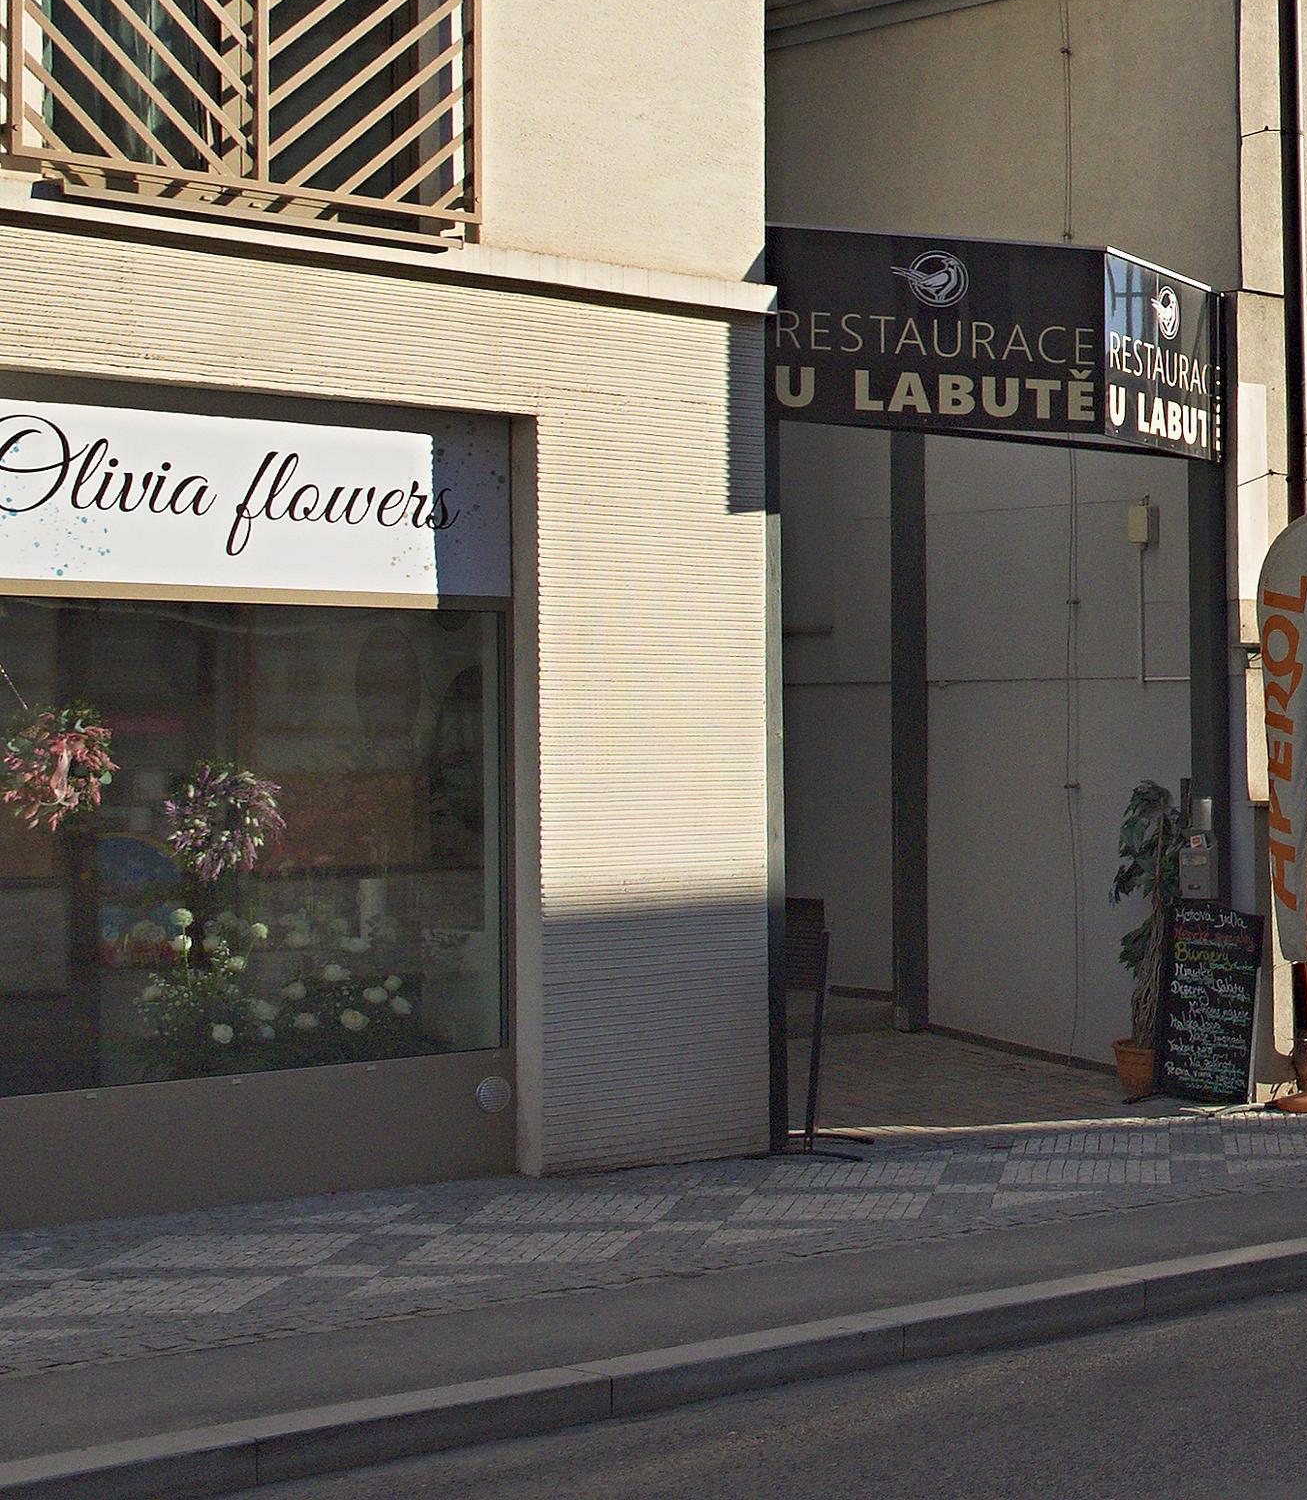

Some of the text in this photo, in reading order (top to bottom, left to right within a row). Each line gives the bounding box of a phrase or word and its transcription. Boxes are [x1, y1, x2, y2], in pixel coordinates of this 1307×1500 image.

[775, 309, 1096, 366] RESTAURACE
[775, 365, 1096, 422] U LABUTĚ
[1109, 384, 1220, 451] U LABUT
[0, 414, 461, 557] Olivia flowers
